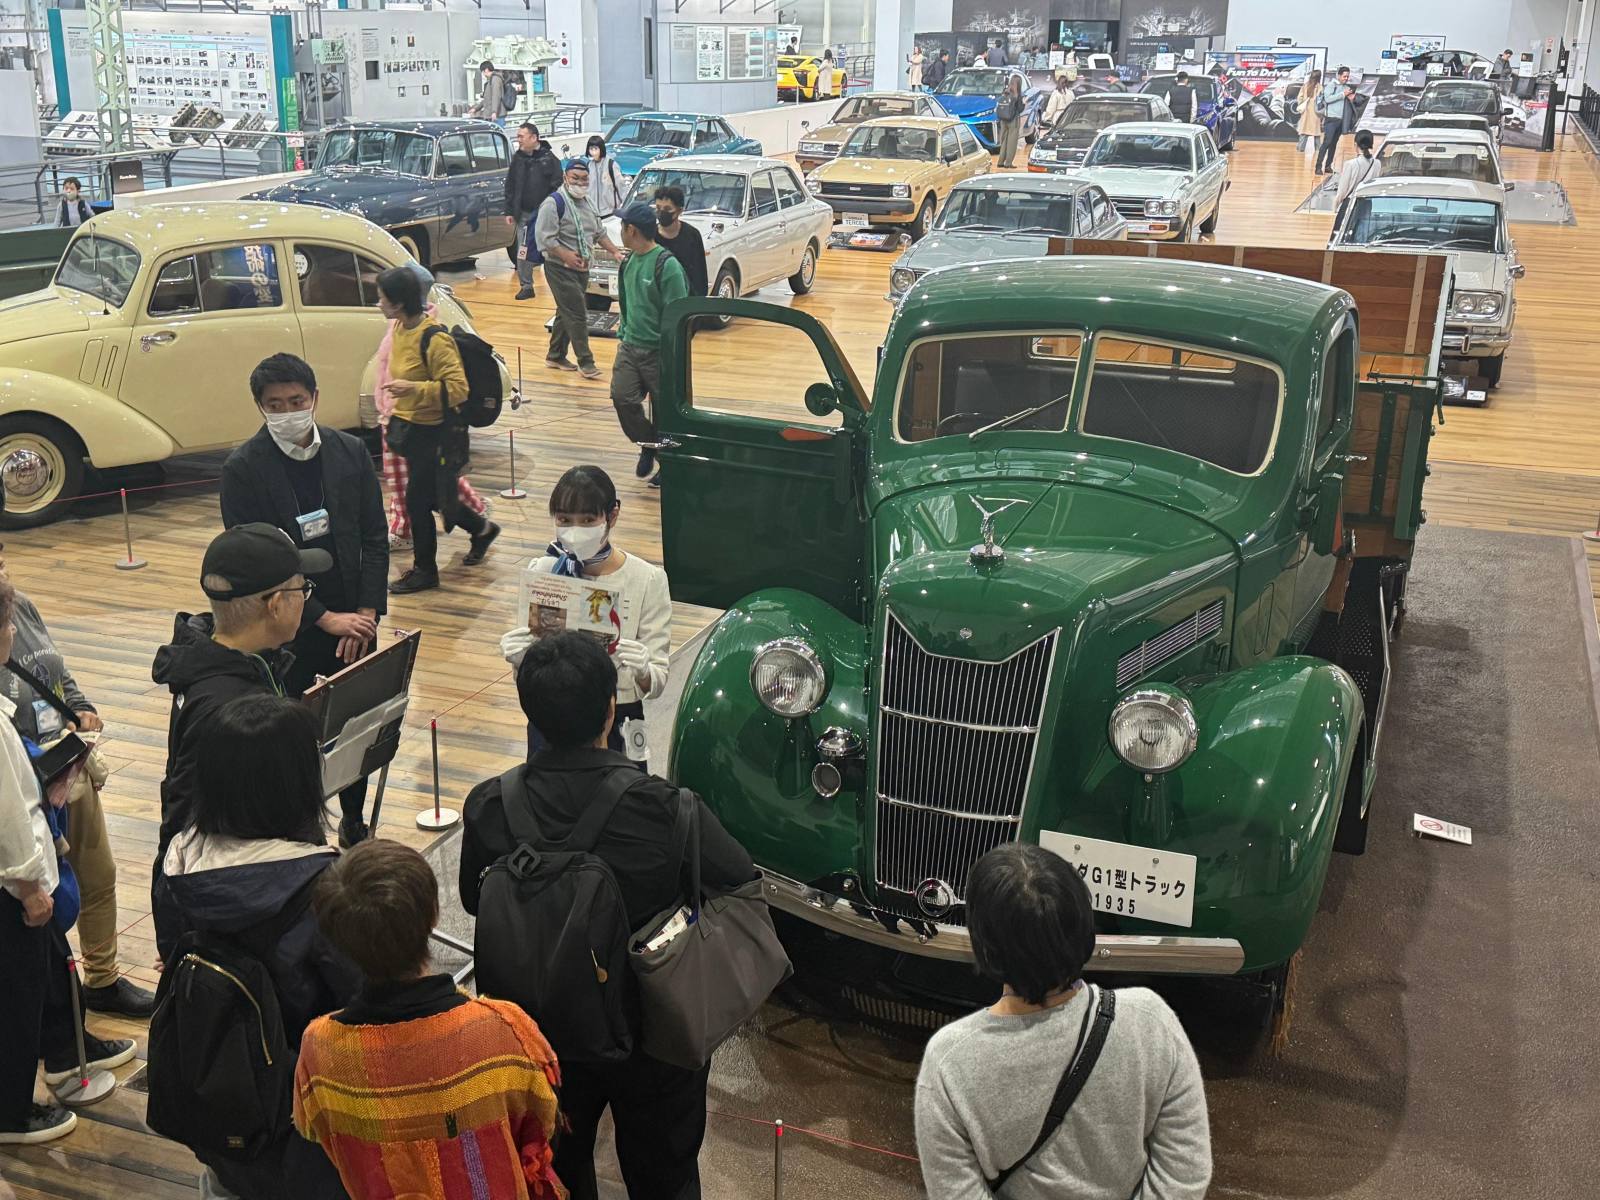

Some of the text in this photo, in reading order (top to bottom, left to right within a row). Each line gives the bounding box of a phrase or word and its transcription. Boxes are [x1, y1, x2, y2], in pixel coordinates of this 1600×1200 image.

[1226, 67, 1245, 76] Fun
[1076, 862, 1186, 899] ダG1型トラック
[1095, 892, 1136, 915] 1935
